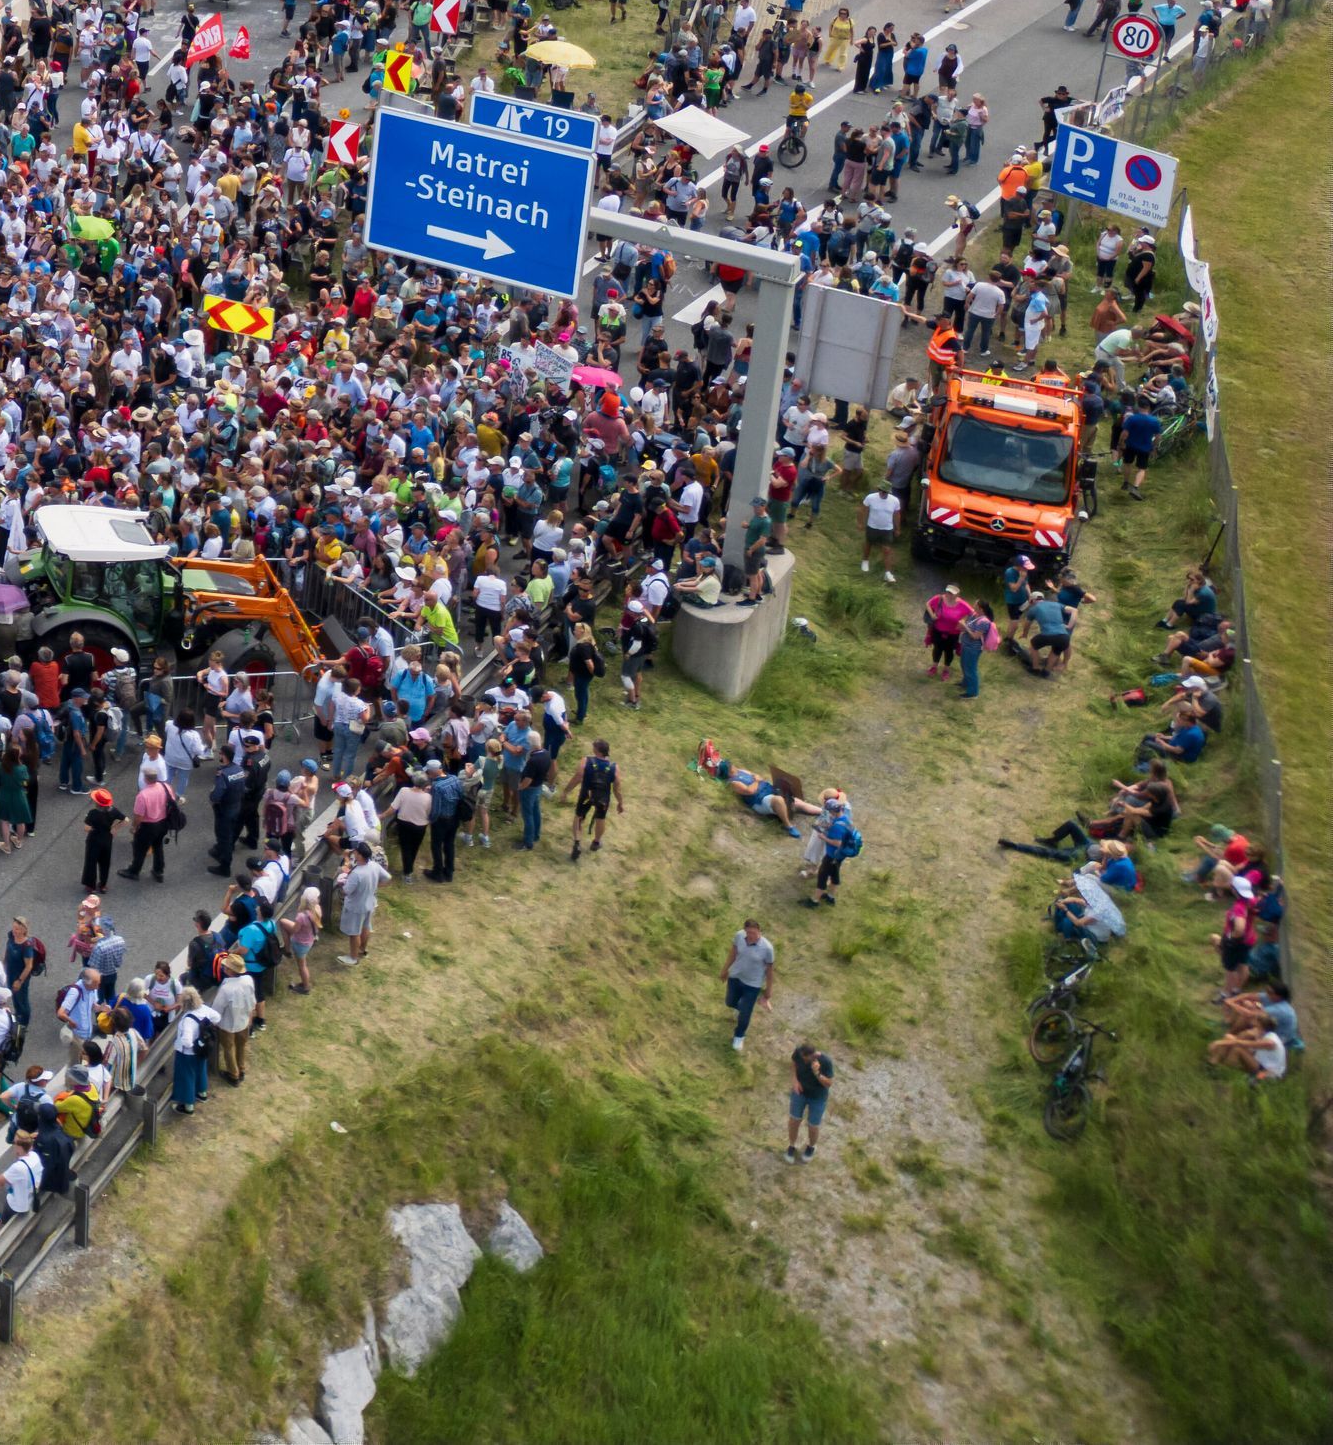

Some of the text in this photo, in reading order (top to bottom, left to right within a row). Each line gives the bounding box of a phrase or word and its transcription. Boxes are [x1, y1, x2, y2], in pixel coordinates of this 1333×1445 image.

[1123, 26, 1149, 50] 80
[543, 116, 570, 139] 19
[430, 140, 529, 186] Matrei
[1064, 131, 1095, 174] P
[405, 174, 548, 229] -Steinach
